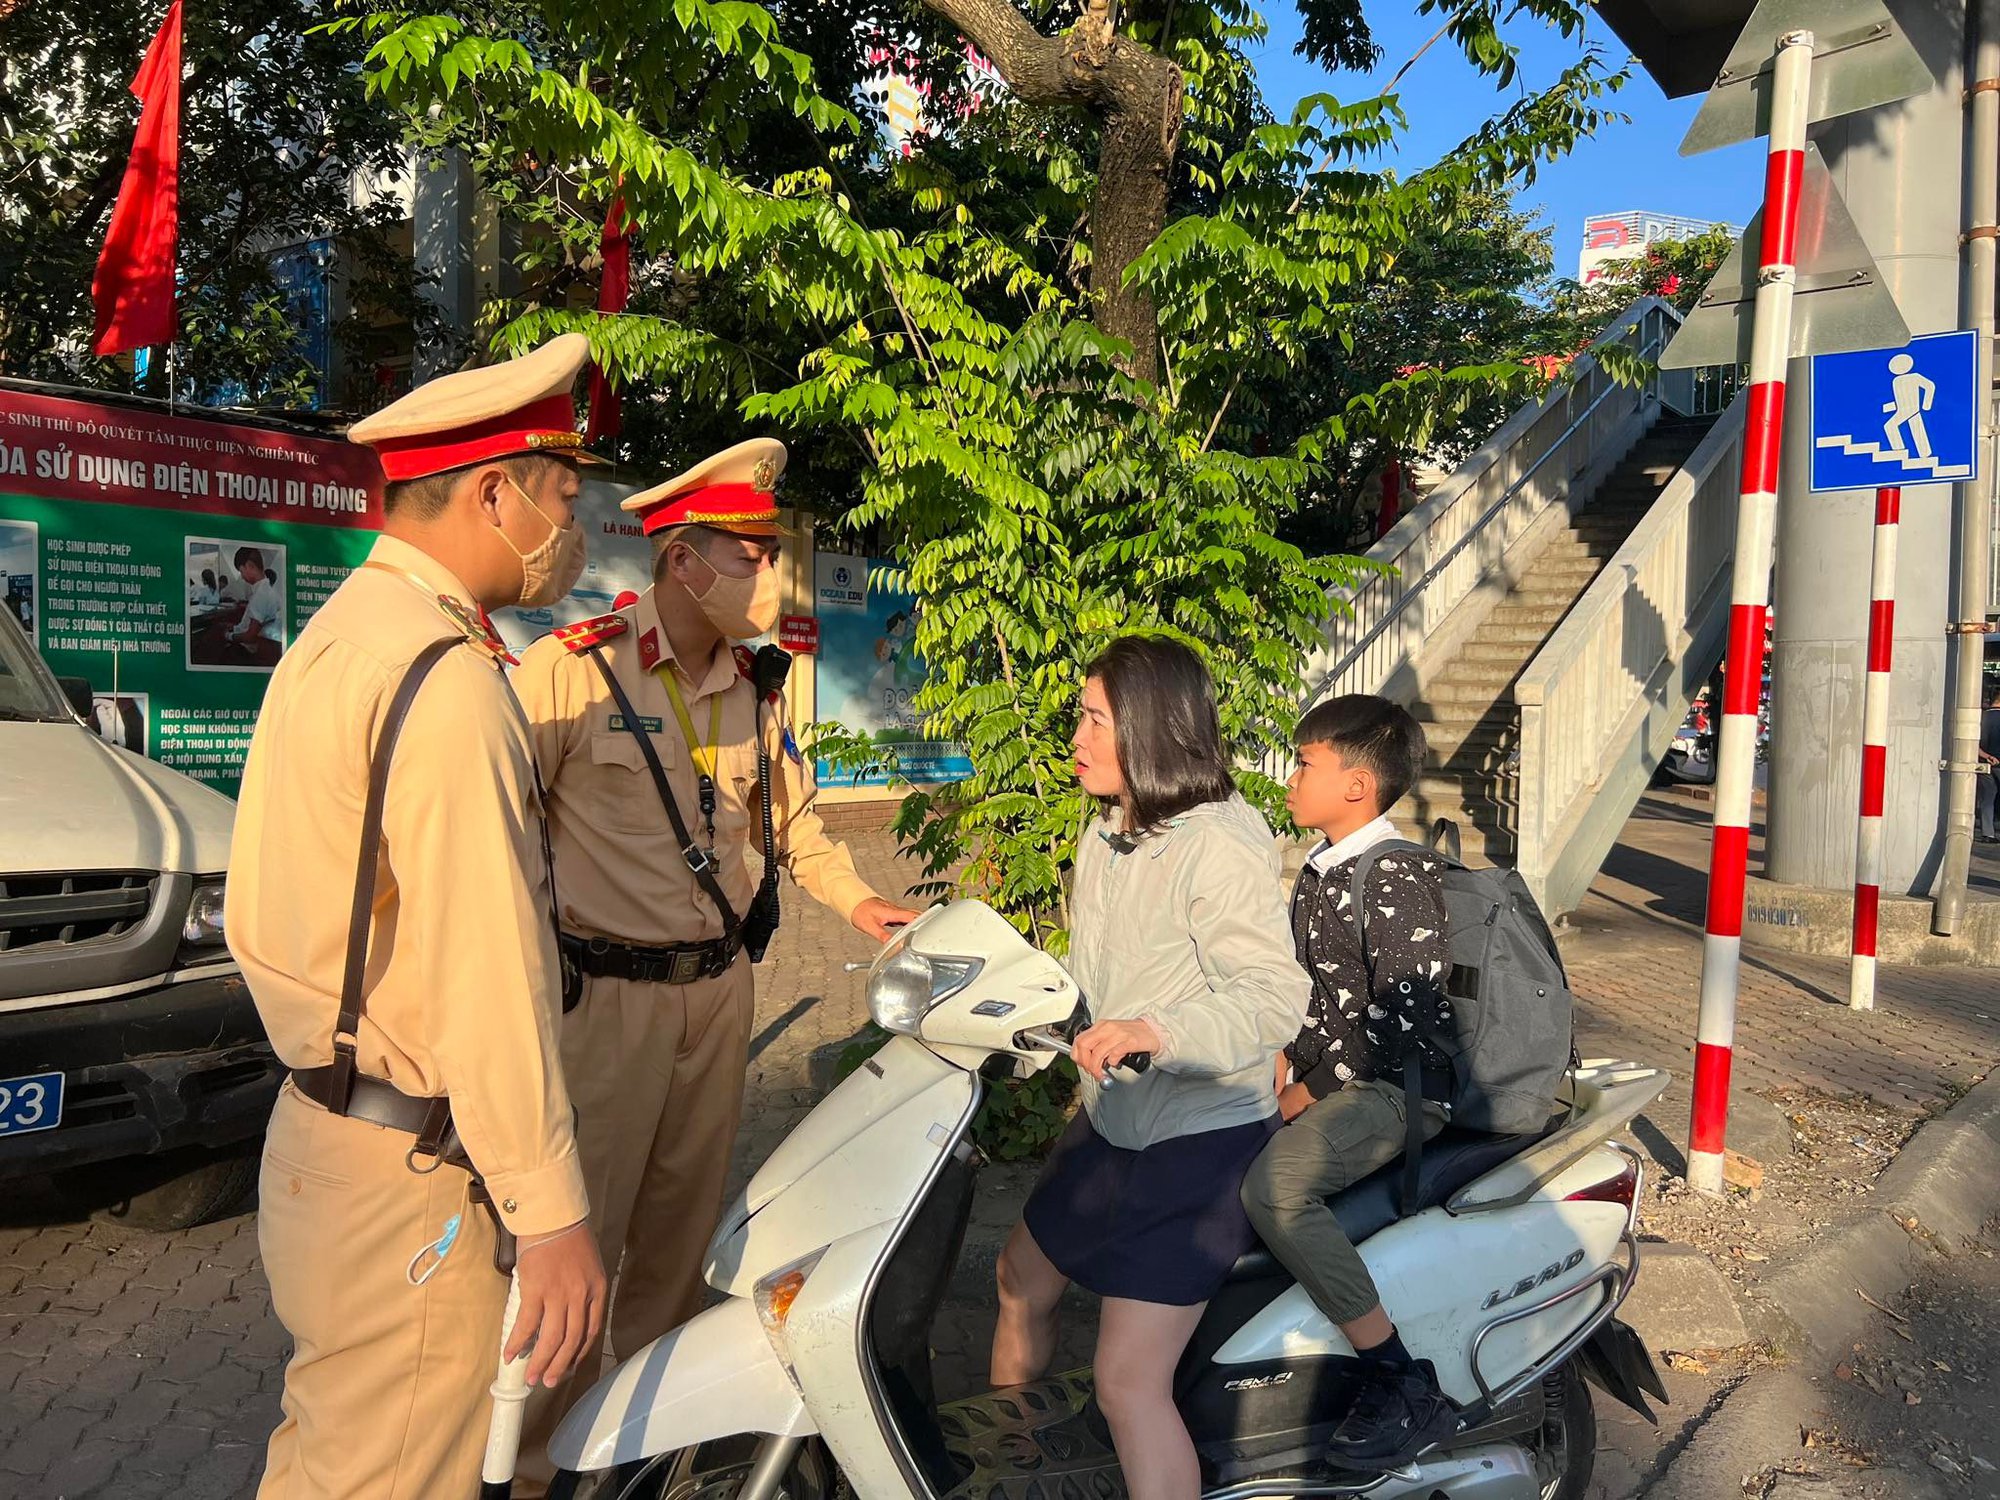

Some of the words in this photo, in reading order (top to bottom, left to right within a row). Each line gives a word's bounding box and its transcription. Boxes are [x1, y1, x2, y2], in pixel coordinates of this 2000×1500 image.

[8, 412, 42, 429] SINH
[45, 416, 73, 433] THỦ
[76, 419, 97, 435] ĐÔ
[99, 424, 144, 442] QUYẾT
[147, 429, 175, 446] TÂM
[178, 435, 213, 452] THỰC
[216, 440, 245, 457] HIỆN
[248, 446, 294, 462] NGHIÊM
[297, 450, 320, 466] TÚC
[35, 442, 73, 480] SỬ
[78, 454, 147, 490] DỤNG
[153, 461, 209, 499] ĐIỆN
[216, 471, 279, 508] THOẠI
[286, 479, 306, 507] DI
[312, 480, 368, 515] ĐỘNG
[604, 520, 616, 535] LÀ
[47, 538, 63, 553] HỌC
[65, 540, 86, 553] SINH
[87, 540, 109, 557] ĐƯỢC
[110, 542, 132, 556] PHÉP
[60, 559, 83, 575] DỤNG
[85, 560, 104, 576] ĐIỆN
[106, 562, 129, 578] THOẠI
[130, 565, 139, 576] DI
[140, 564, 161, 579] ĐỘNG
[296, 564, 311, 576] HỌC
[312, 565, 329, 575] SINH
[60, 579, 75, 594] GỌI
[76, 580, 93, 592] CHO
[94, 579, 119, 594] NGƯỜI
[121, 580, 142, 595] THÂN
[847, 590, 863, 601] EDU
[48, 597, 75, 611] TRONG
[76, 597, 108, 612] TRƯỜNG
[110, 600, 126, 616] HỢP
[48, 617, 70, 632] ĐƯỢC
[72, 618, 85, 633] SỰ
[167, 622, 185, 635] GIÁO
[48, 635, 59, 649] VÀ
[60, 638, 78, 650] BAN
[80, 637, 101, 651] GIÁM
[122, 637, 139, 652] NHÀ
[141, 639, 171, 653] TRƯỜNG
[160, 708, 191, 719] NGOÀI
[193, 708, 212, 719] CÁC
[232, 709, 250, 720] QUY
[160, 724, 181, 736] HỌC
[183, 724, 206, 734] SINH
[208, 722, 240, 734] KHÔNG
[160, 737, 184, 751] ĐIỆN
[186, 738, 213, 751] THOẠI
[215, 739, 225, 749] DI
[160, 753, 174, 764] CÓ
[176, 752, 193, 766] NỘI
[195, 754, 221, 764] DUNG
[1480, 1247, 1585, 1311] LEAD
